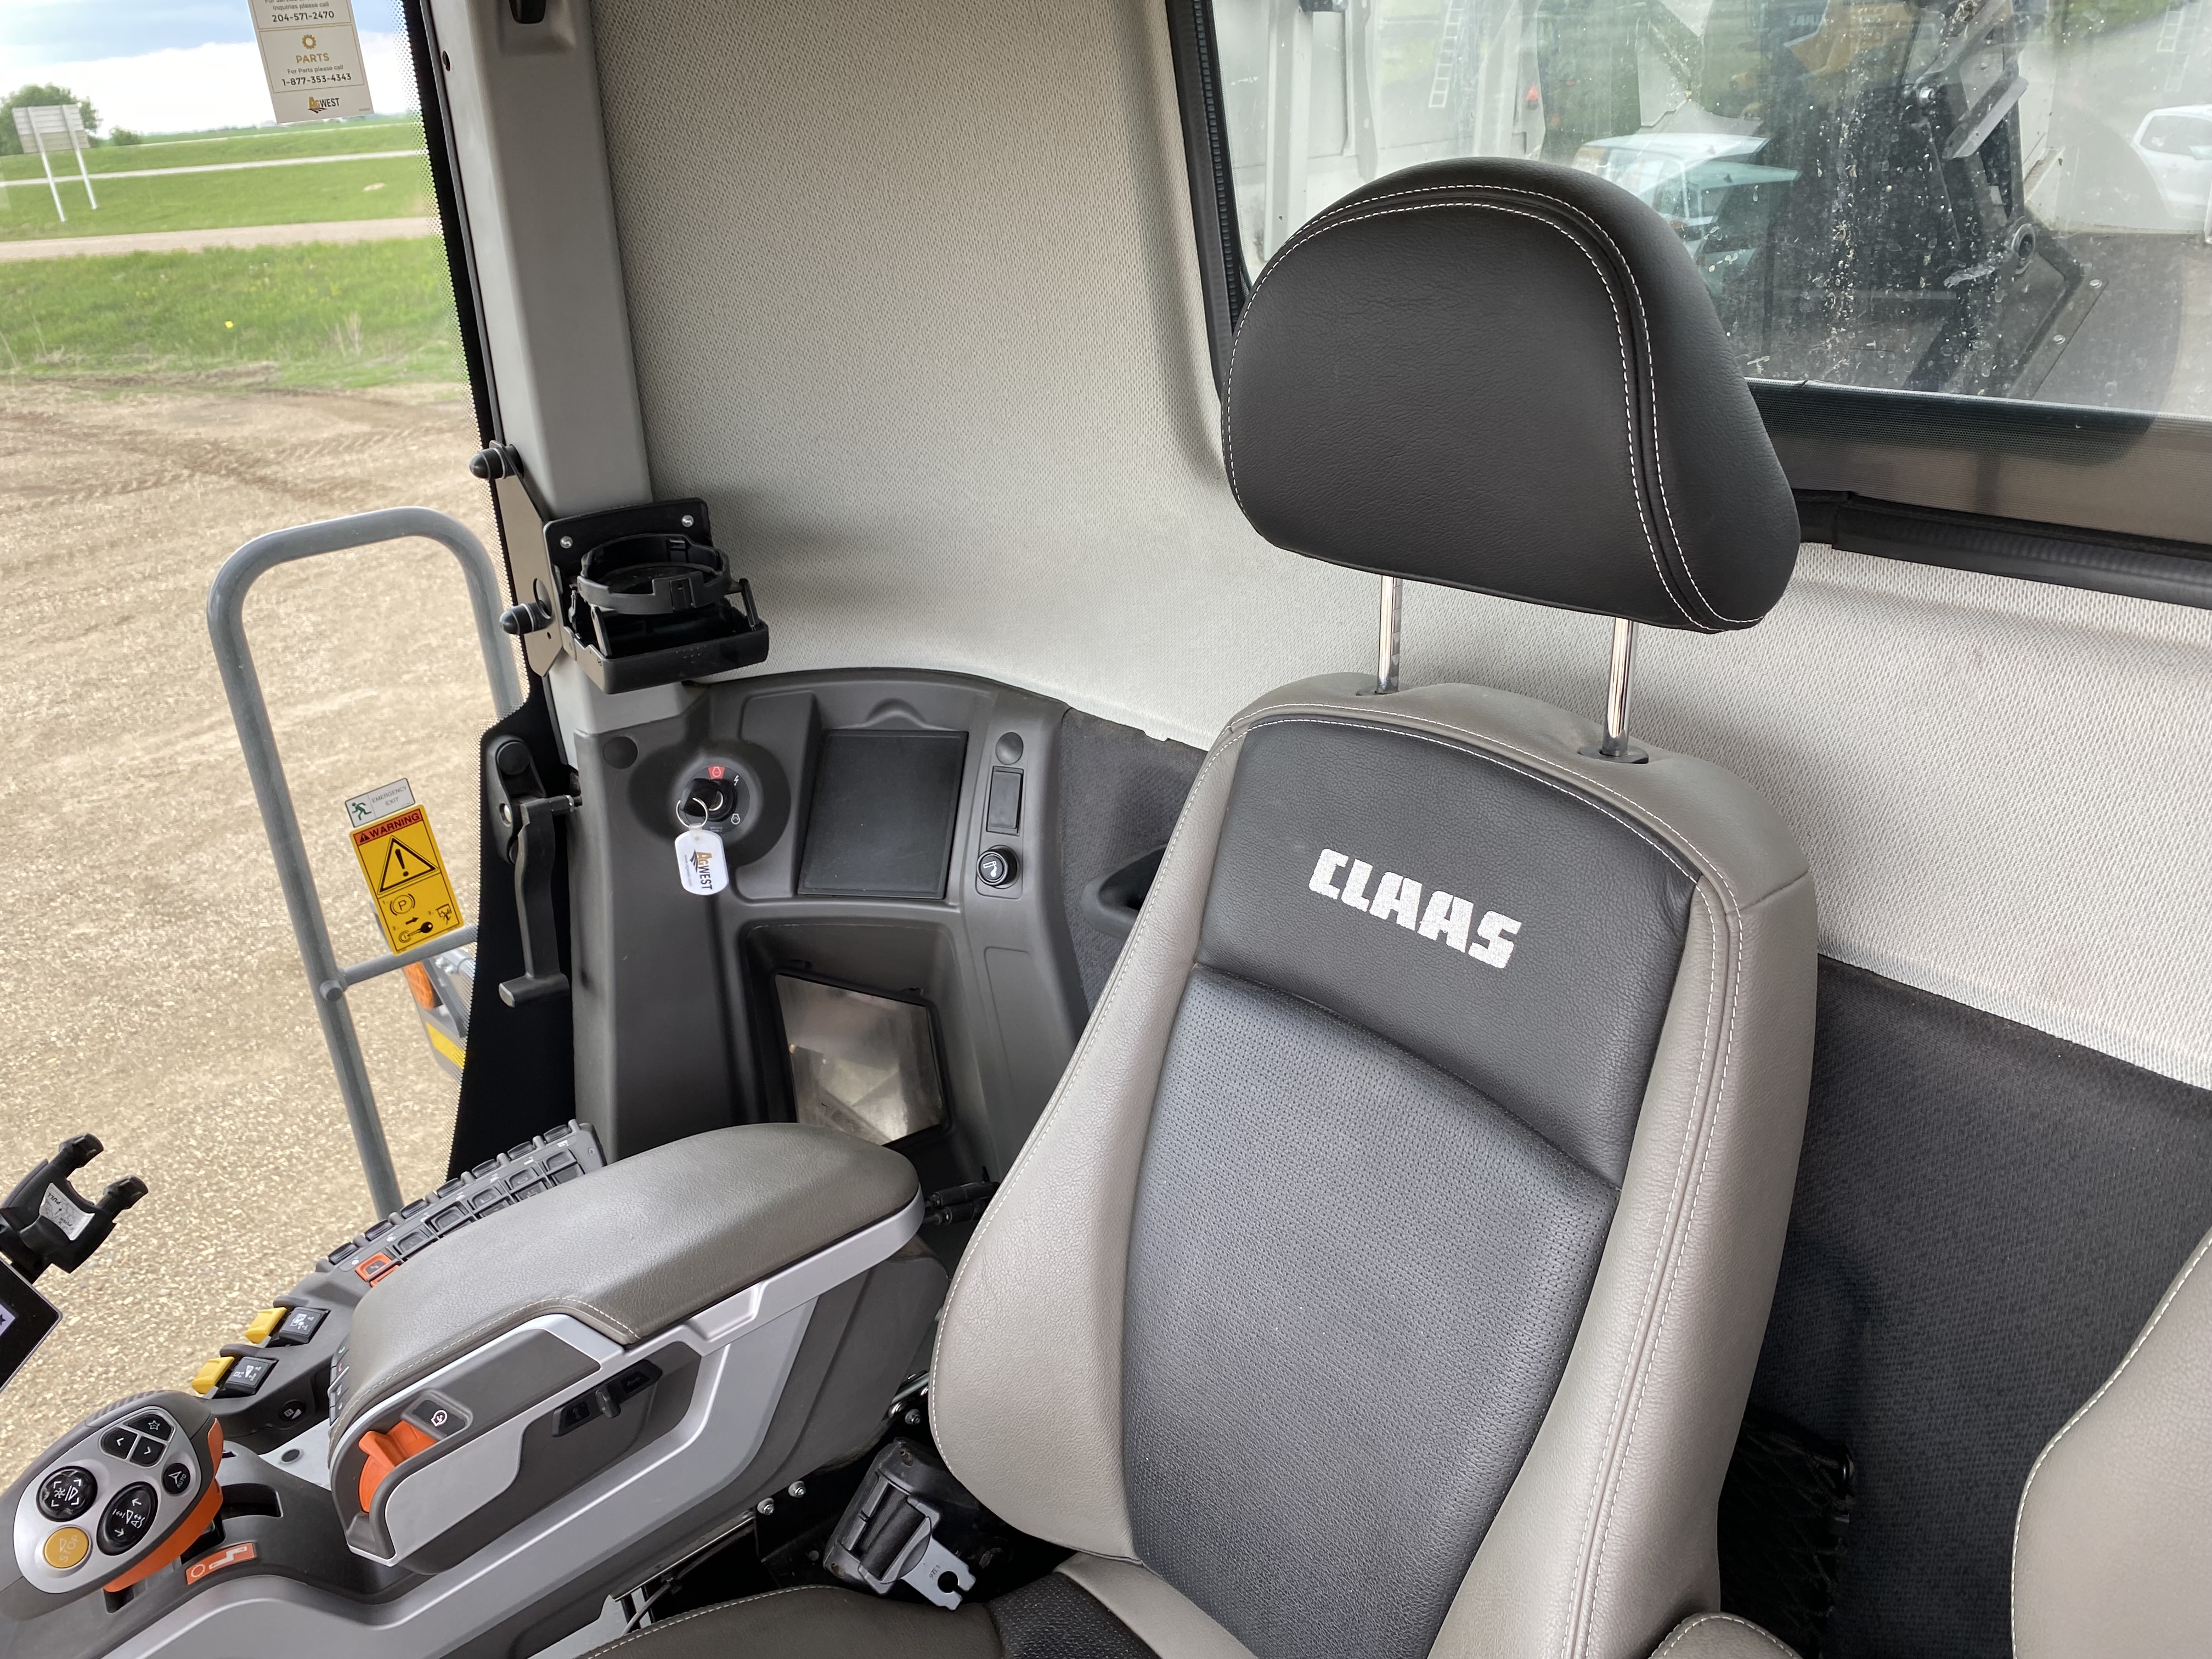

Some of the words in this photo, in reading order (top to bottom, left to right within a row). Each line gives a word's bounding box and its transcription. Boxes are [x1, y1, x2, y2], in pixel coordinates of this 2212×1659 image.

[272, 10, 334, 22] 204-571-2470
[296, 53, 330, 64] PARTS
[281, 72, 352, 86] 1-877-353-4343
[371, 786, 407, 803] EMERGENCY
[385, 797, 399, 806] EXIT
[369, 812, 420, 838] WARNING
[398, 900, 407, 911] P
[1308, 848, 1522, 969] CLAAS
[47, 1192, 61, 1205] PULL
[59, 1217, 73, 1227] PUSH
[176, 1473, 187, 1489] AUTO
[59, 1534, 79, 1563] STOP
